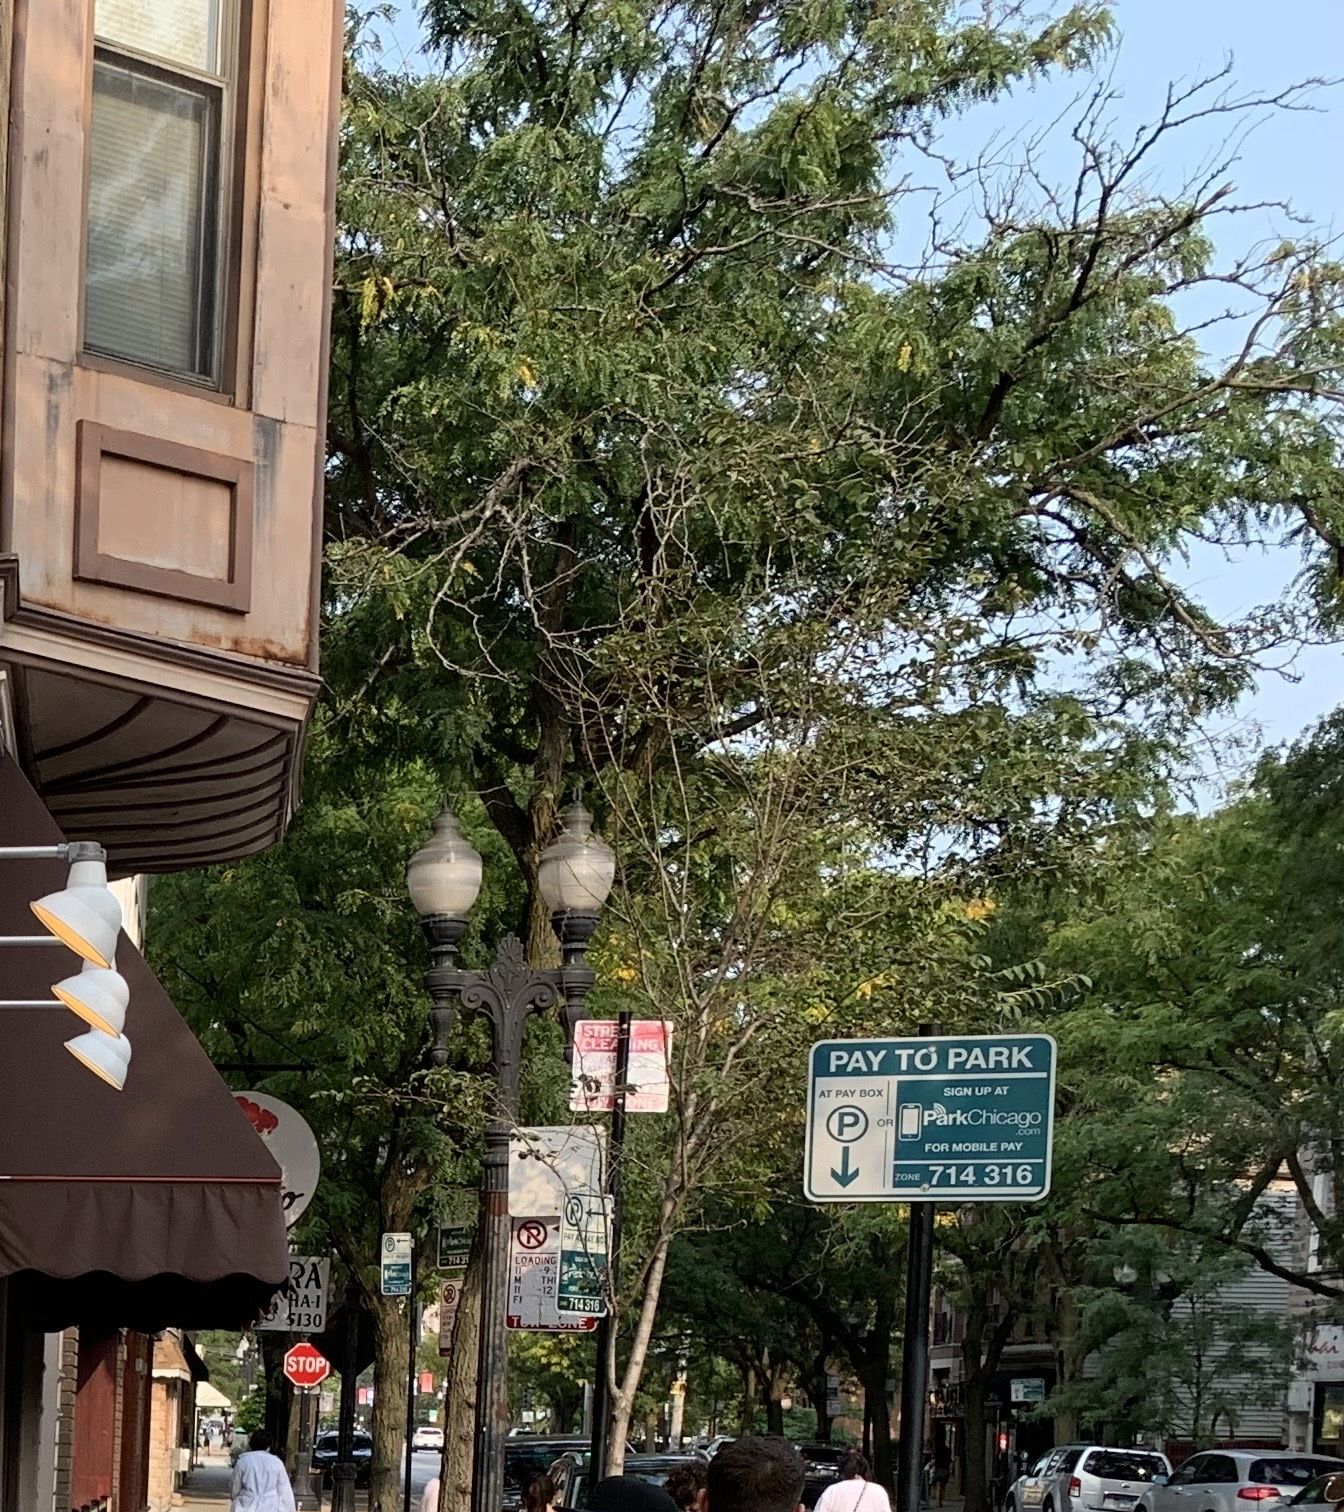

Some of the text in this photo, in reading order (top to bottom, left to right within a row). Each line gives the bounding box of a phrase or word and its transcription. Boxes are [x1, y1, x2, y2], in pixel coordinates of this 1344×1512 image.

[582, 1038, 658, 1052] CLEAING
[829, 1046, 1034, 1073] PAY TO PARK
[819, 1088, 883, 1098] AT PAY BOX
[943, 1086, 1009, 1097] SIGN UP AT
[877, 1118, 894, 1128] OR
[923, 1108, 1042, 1128] ParkChicago
[1015, 1126, 1041, 1136] .com
[925, 1142, 1023, 1153] FOR MOBILE PAY
[895, 1165, 1033, 1185] ZONE 714 316
[515, 1256, 557, 1266] LOADING
[569, 1298, 600, 1312] 714 316
[288, 1354, 326, 1373] STOP
